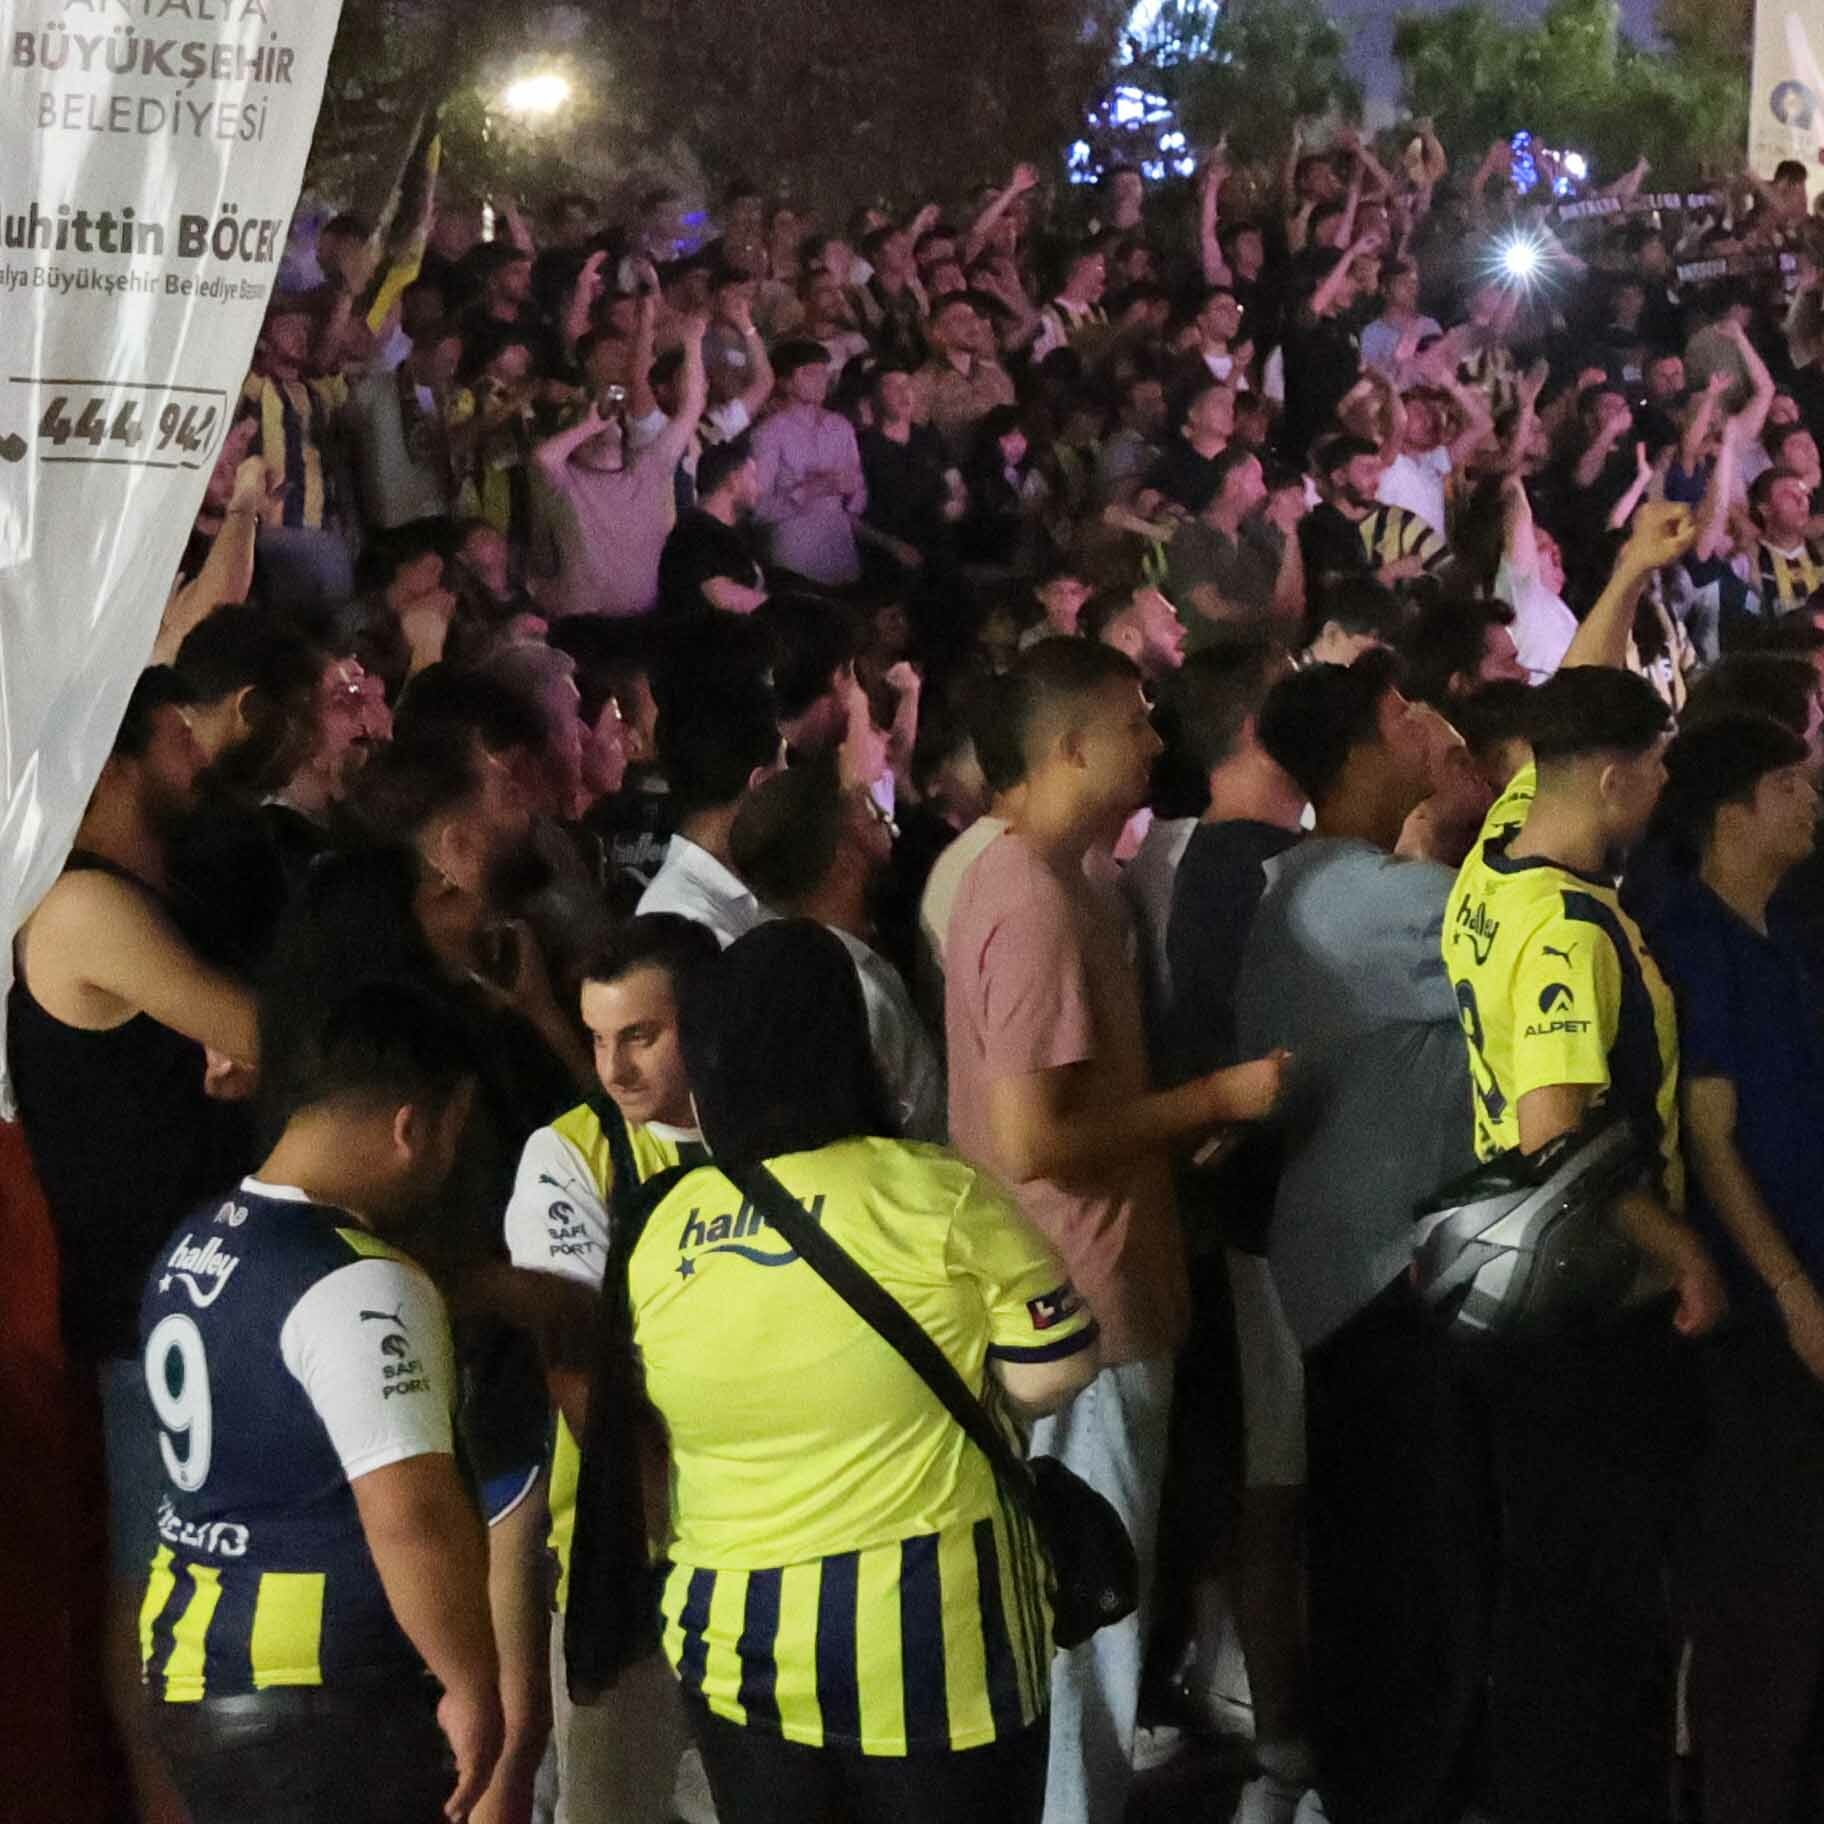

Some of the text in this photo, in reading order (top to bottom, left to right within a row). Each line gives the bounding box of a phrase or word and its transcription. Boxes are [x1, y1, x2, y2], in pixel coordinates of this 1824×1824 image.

[13, 22, 295, 89] BÜYÜKŞEHİR
[37, 90, 268, 141] BELEDİYESİ
[0, 202, 282, 263] uhittin BÖCEK
[32, 267, 159, 296] Büyükşehir
[165, 277, 238, 304] Belediye
[38, 397, 142, 447] 444
[1524, 1020, 1591, 1038] ALPET
[680, 1194, 826, 1256] hally
[168, 1233, 240, 1307] halley
[145, 1313, 212, 1492] 9
